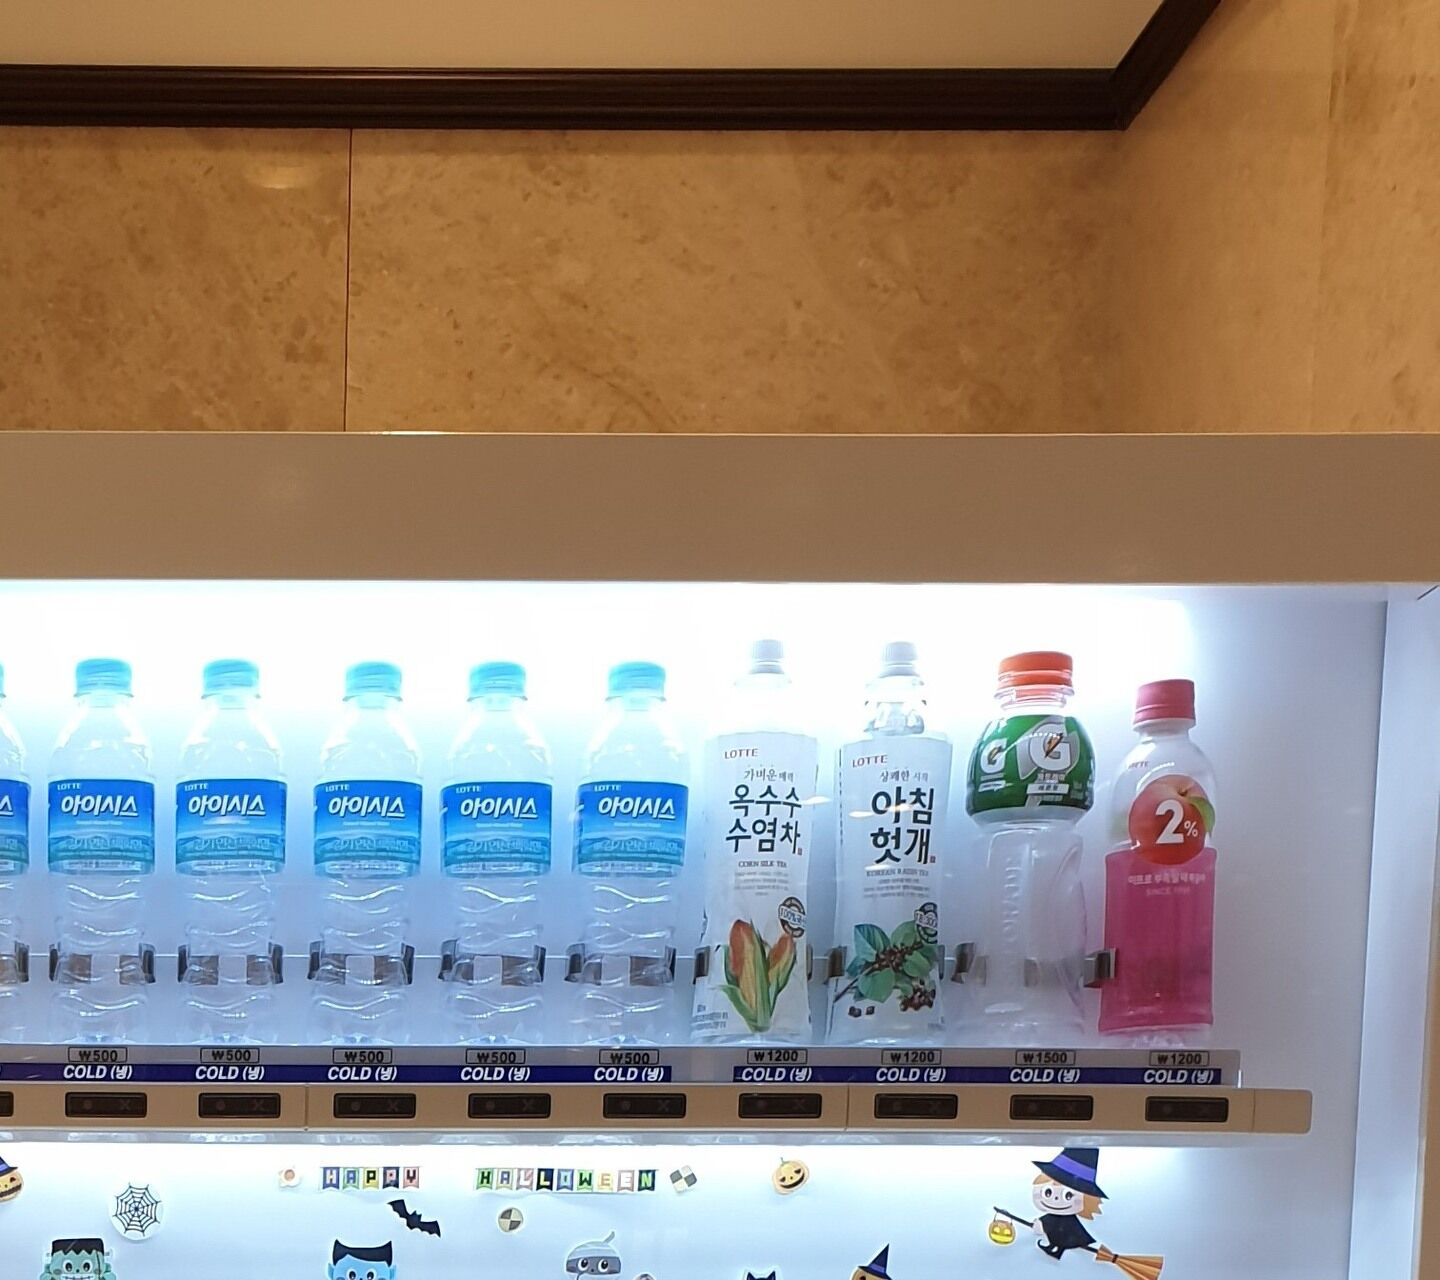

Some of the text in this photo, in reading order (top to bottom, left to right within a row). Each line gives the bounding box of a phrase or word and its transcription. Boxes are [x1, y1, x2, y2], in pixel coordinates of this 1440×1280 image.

[725, 748, 758, 759] LOTTE
[852, 755, 888, 768] LOTTE
[61, 795, 139, 818] 아이시스
[328, 796, 406, 819] 아이시스
[598, 796, 676, 820] 아이시스
[729, 784, 802, 818] 옥수수
[871, 786, 935, 826] 아침
[726, 817, 800, 855] 수염차
[870, 827, 931, 865] 헛개
[741, 1067, 785, 1082] COLD
[1009, 1068, 1054, 1082] COLD
[1143, 1069, 1188, 1083] COLD
[323, 1168, 657, 1190] HAPPY HALLOWEEN
